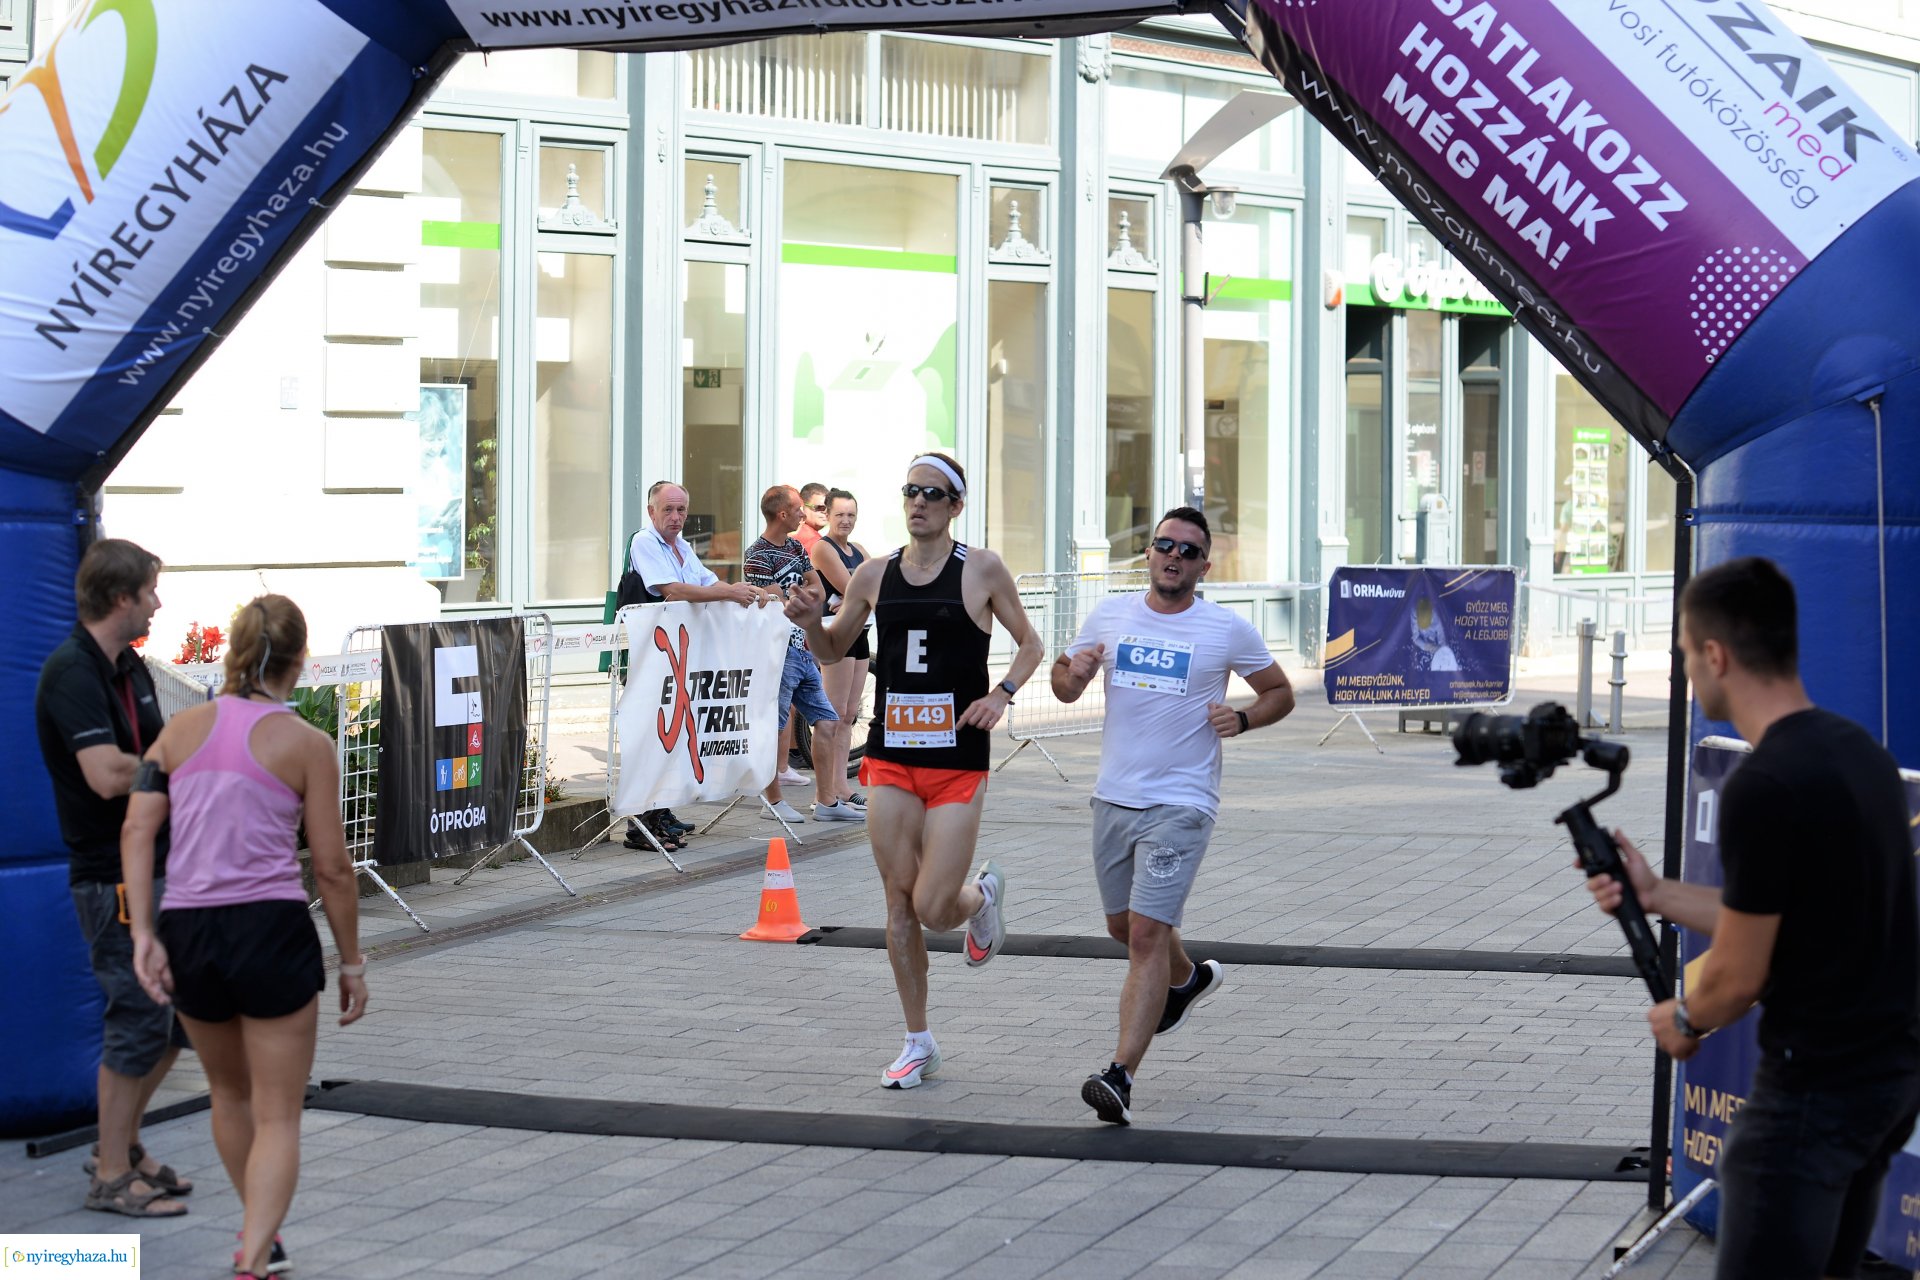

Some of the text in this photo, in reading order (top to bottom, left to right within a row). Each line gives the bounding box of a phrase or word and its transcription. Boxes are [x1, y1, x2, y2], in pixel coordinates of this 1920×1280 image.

[1695, 0, 1886, 164] ZAIK
[1399, 21, 1615, 245] HOZZÁNK
[1656, 43, 1820, 209] futóközösség
[1763, 101, 1853, 182] med
[1382, 72, 1571, 271] MÉG MA!
[34, 61, 290, 352] NYÍREGYHÁZA
[118, 120, 349, 388] www.nyiregyhaza.hu
[1454, 616, 1510, 627] HOGY TE VAGY
[1465, 630, 1509, 641] A LEGJOBB
[905, 629, 928, 673] E
[1130, 646, 1176, 669] 645
[1335, 690, 1358, 701] HOGY
[1359, 687, 1393, 701] NÁLUNK
[1394, 689, 1401, 701] A
[1337, 675, 1347, 686] MI
[697, 704, 750, 734] TRAIL
[892, 706, 946, 725] 1149
[700, 739, 741, 758] HUNGARY
[430, 802, 486, 834] ÖTPRÓBA
[1685, 1082, 1706, 1117] MI
